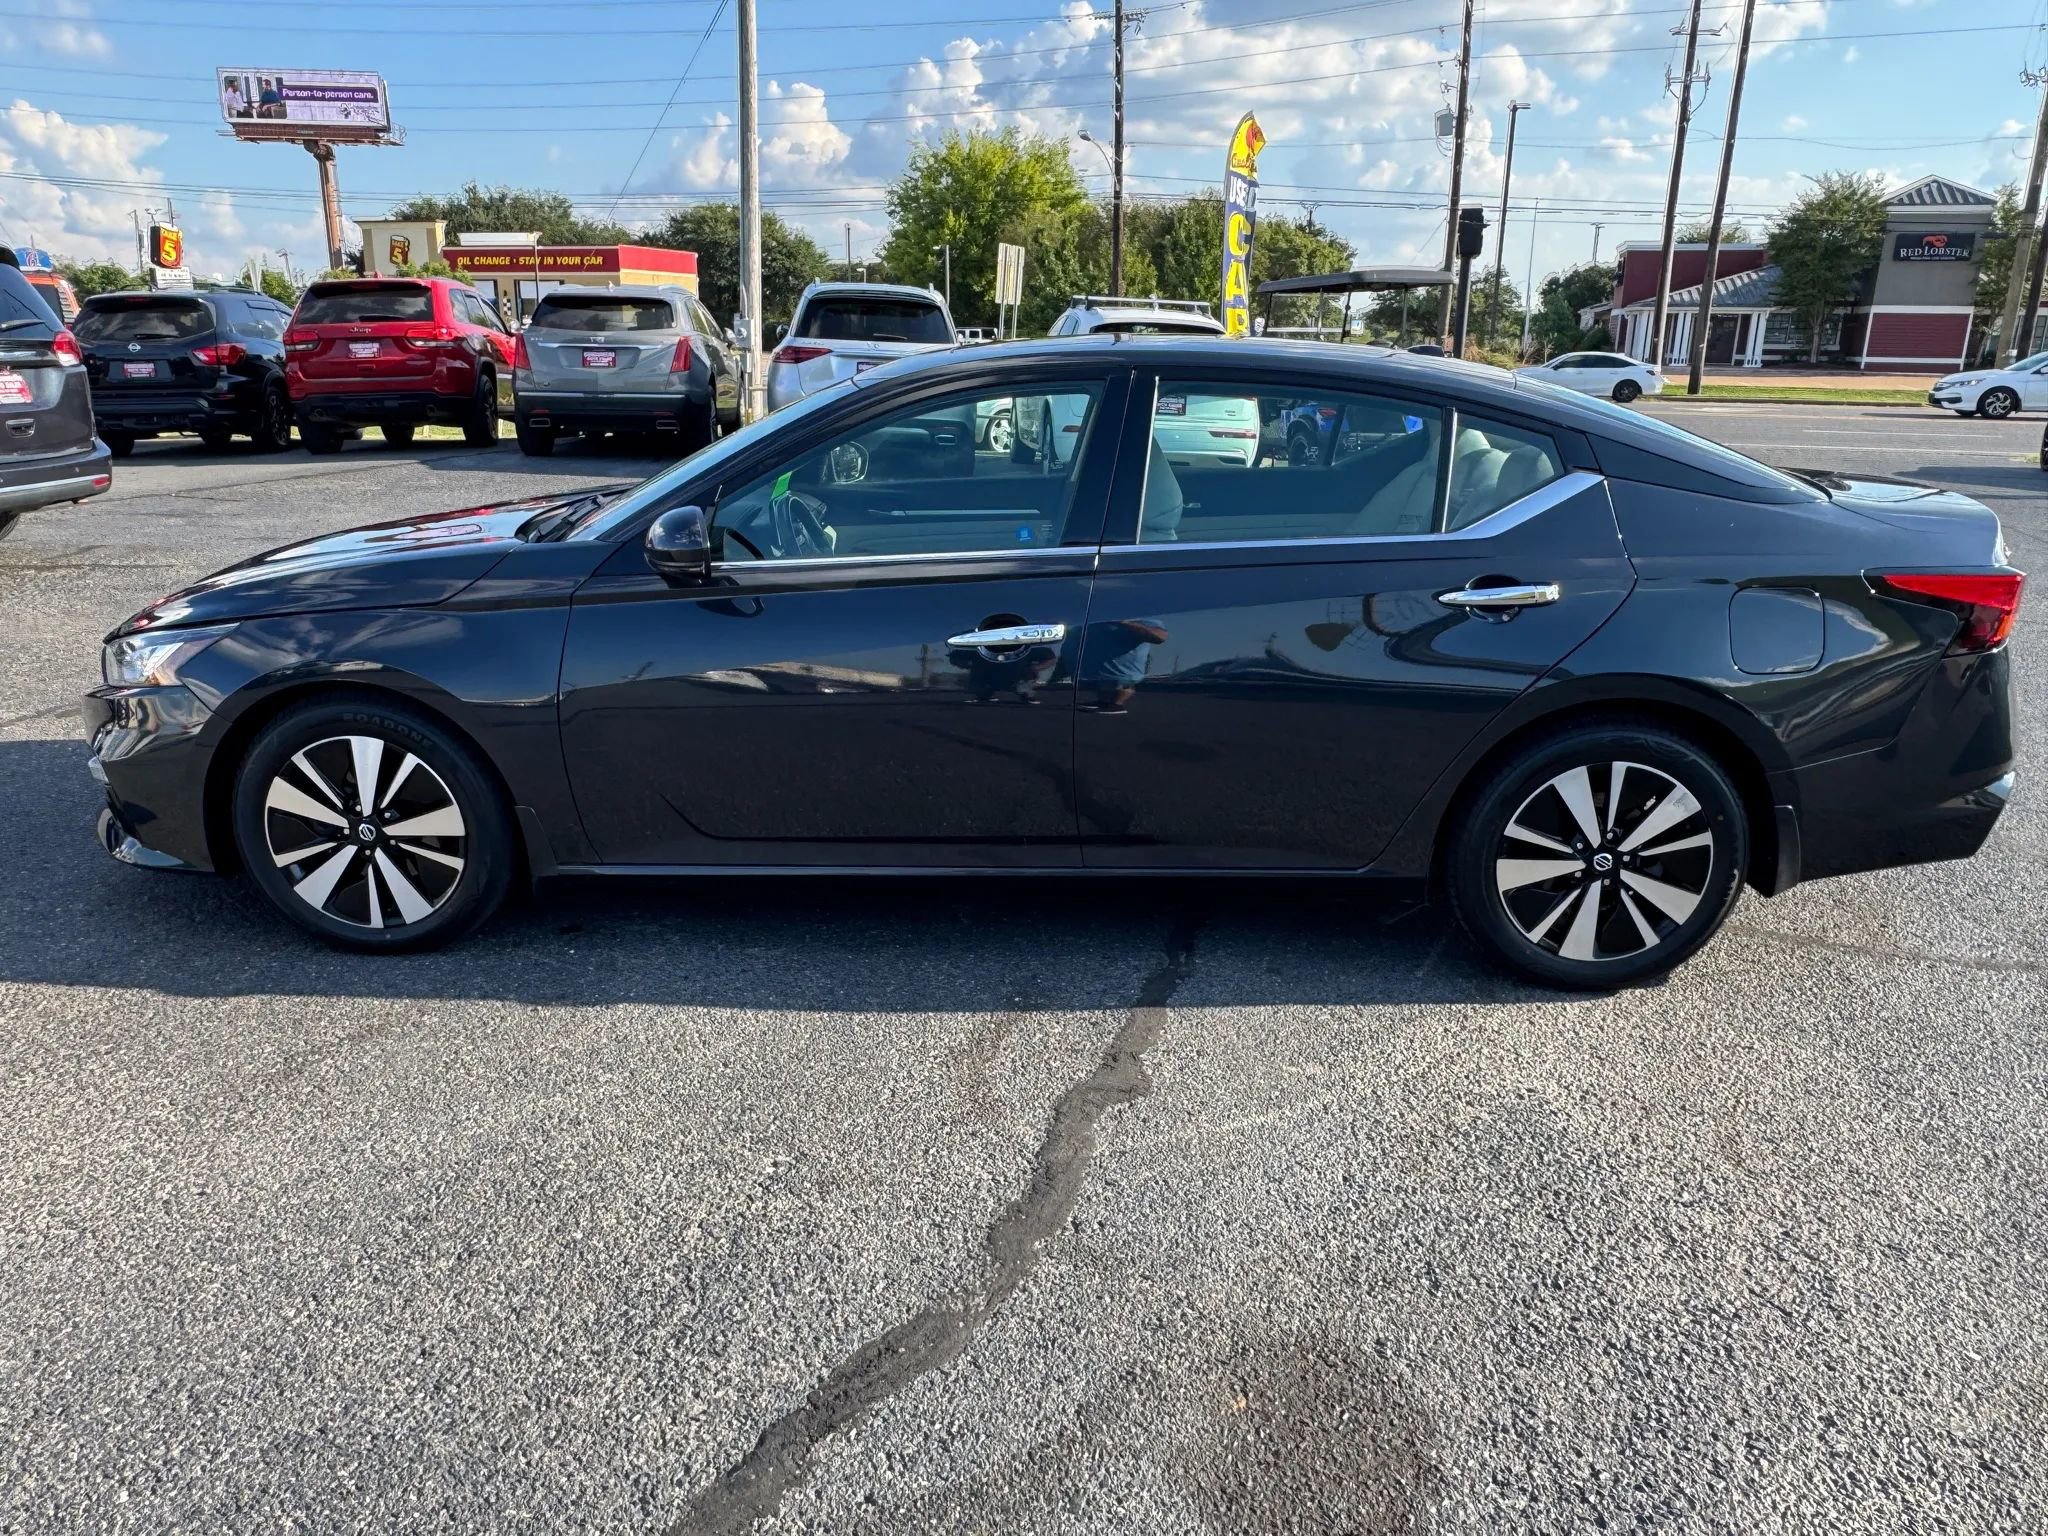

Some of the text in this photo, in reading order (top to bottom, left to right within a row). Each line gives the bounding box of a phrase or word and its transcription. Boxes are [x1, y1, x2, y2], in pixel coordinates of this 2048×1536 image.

[282, 88, 374, 99] Person-to-person care.
[161, 239, 177, 261] 5
[391, 247, 403, 264] 5
[1900, 246, 1970, 258] RED LOBSTER
[457, 256, 604, 265] OIL CHANGE STAY IN YOUR CAR
